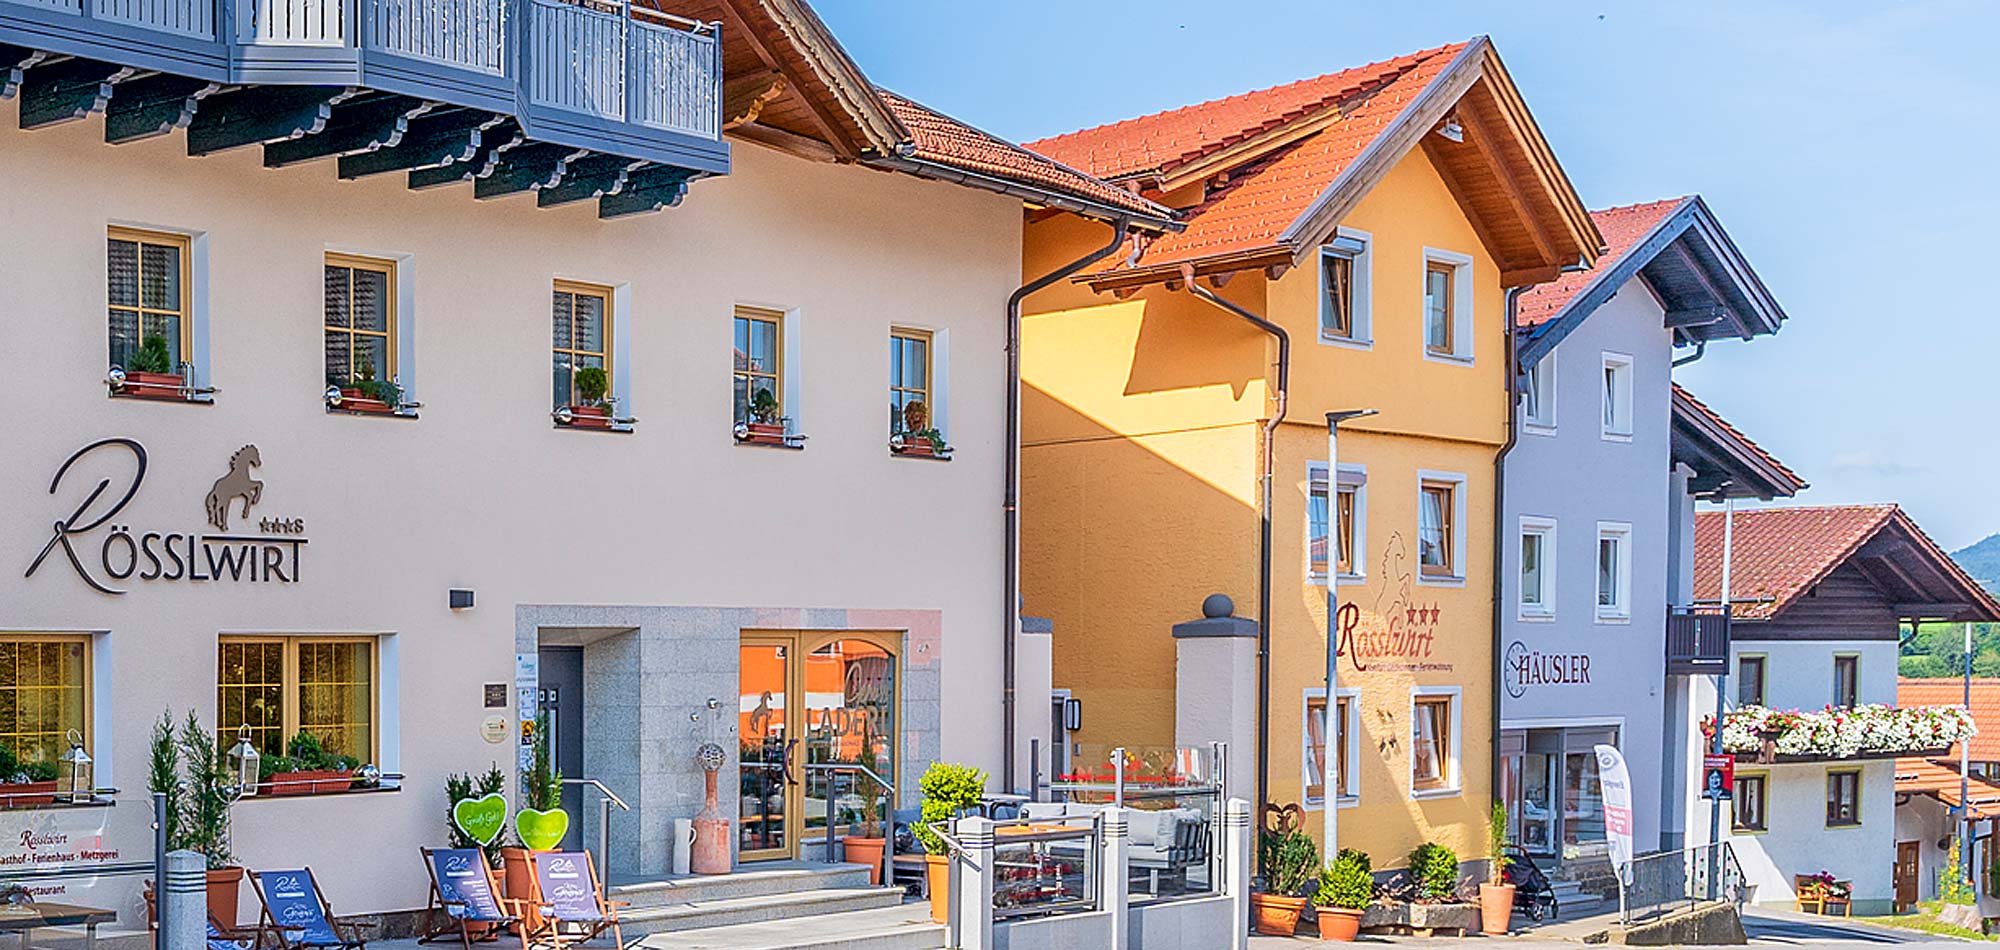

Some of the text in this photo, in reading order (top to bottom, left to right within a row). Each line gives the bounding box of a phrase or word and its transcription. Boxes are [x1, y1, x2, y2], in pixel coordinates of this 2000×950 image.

[1518, 651, 1591, 684] HÄUSLER
[0, 849, 119, 864] asthof Ferienhaus Metzgerei
